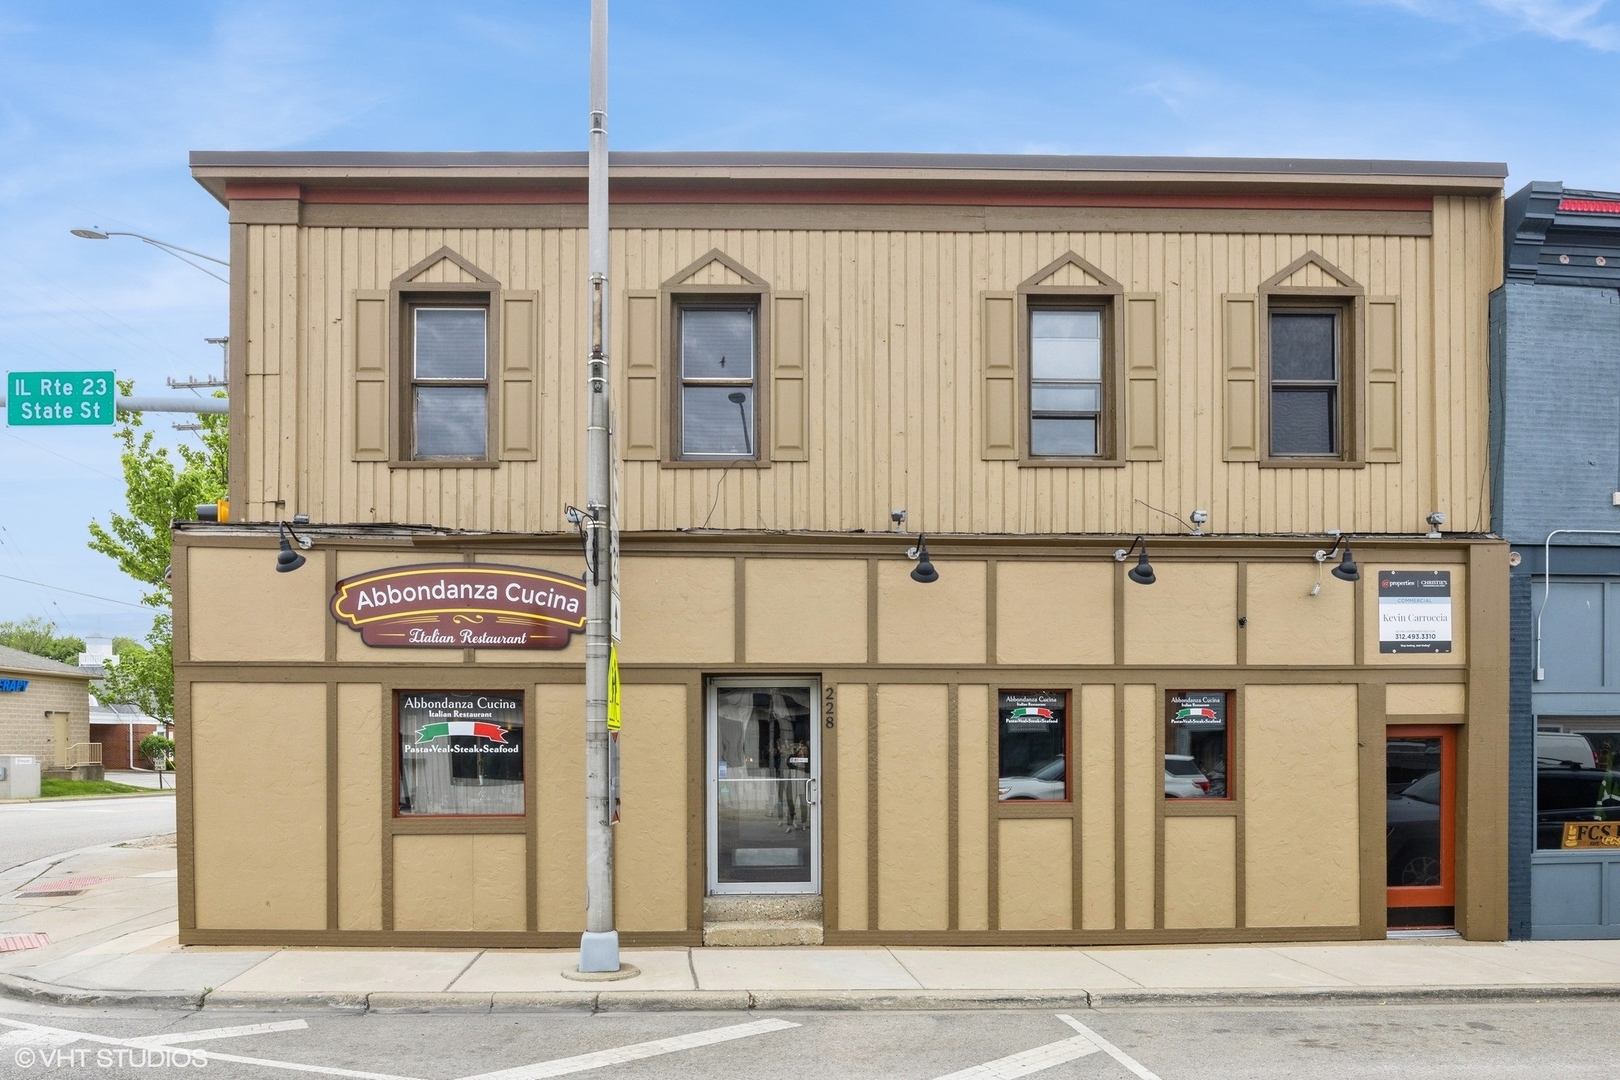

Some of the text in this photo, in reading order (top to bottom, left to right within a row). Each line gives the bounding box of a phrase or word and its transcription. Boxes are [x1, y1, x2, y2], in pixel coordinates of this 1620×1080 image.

[15, 379, 107, 396] IL Rte 23
[21, 402, 101, 419] State St
[357, 580, 579, 613] Abbondanza Cucina
[1383, 613, 1448, 622] Kevin Carroccia
[409, 628, 527, 644] Italian Restaurant
[404, 697, 516, 709] Abbondanza Cucina
[429, 710, 492, 718] Italian Restaurant
[1577, 825, 1611, 840] FCS
